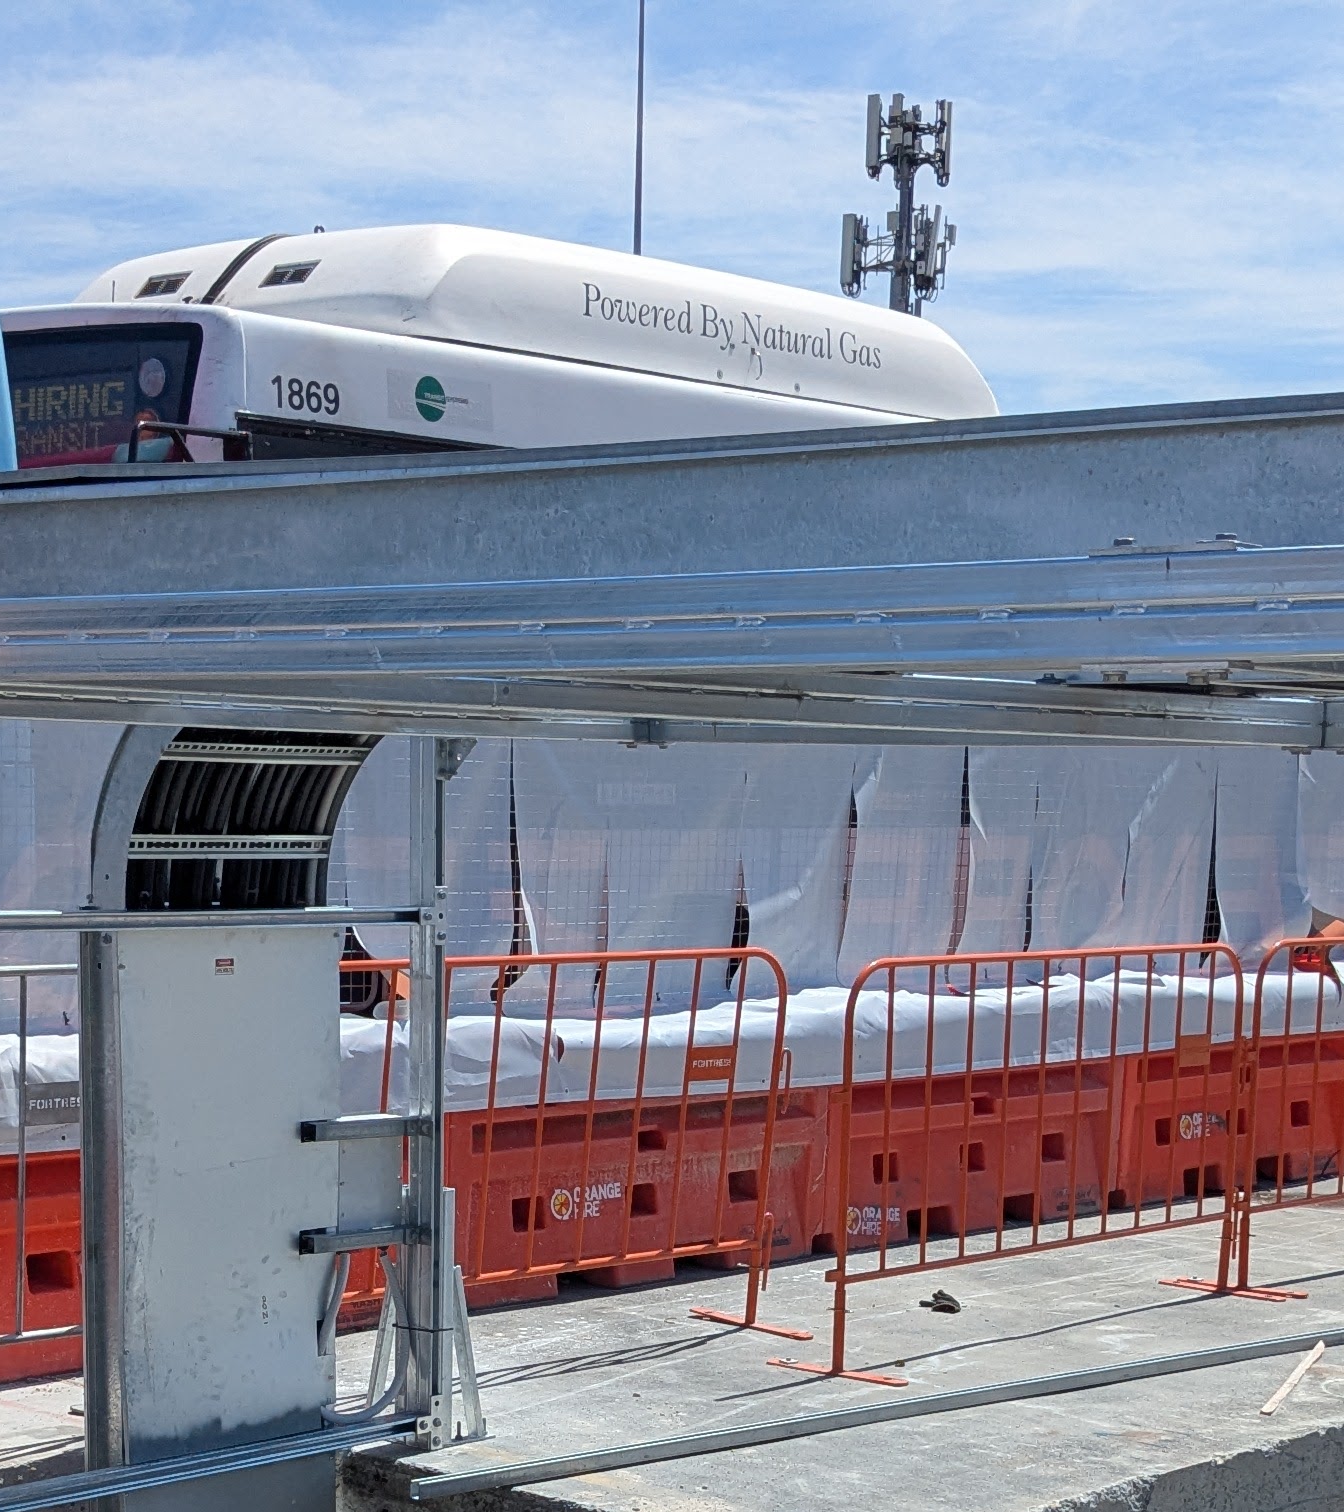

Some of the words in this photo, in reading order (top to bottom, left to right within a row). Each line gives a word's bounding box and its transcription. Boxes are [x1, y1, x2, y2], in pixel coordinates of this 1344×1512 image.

[582, 282, 693, 334] Powered
[700, 303, 735, 351] By
[741, 311, 832, 360] Natural
[839, 331, 881, 370] Gas
[15, 381, 125, 421] HIRING
[271, 375, 340, 415] 1869
[16, 421, 104, 455] RANSIT
[29, 1096, 81, 1110] FORTRES
